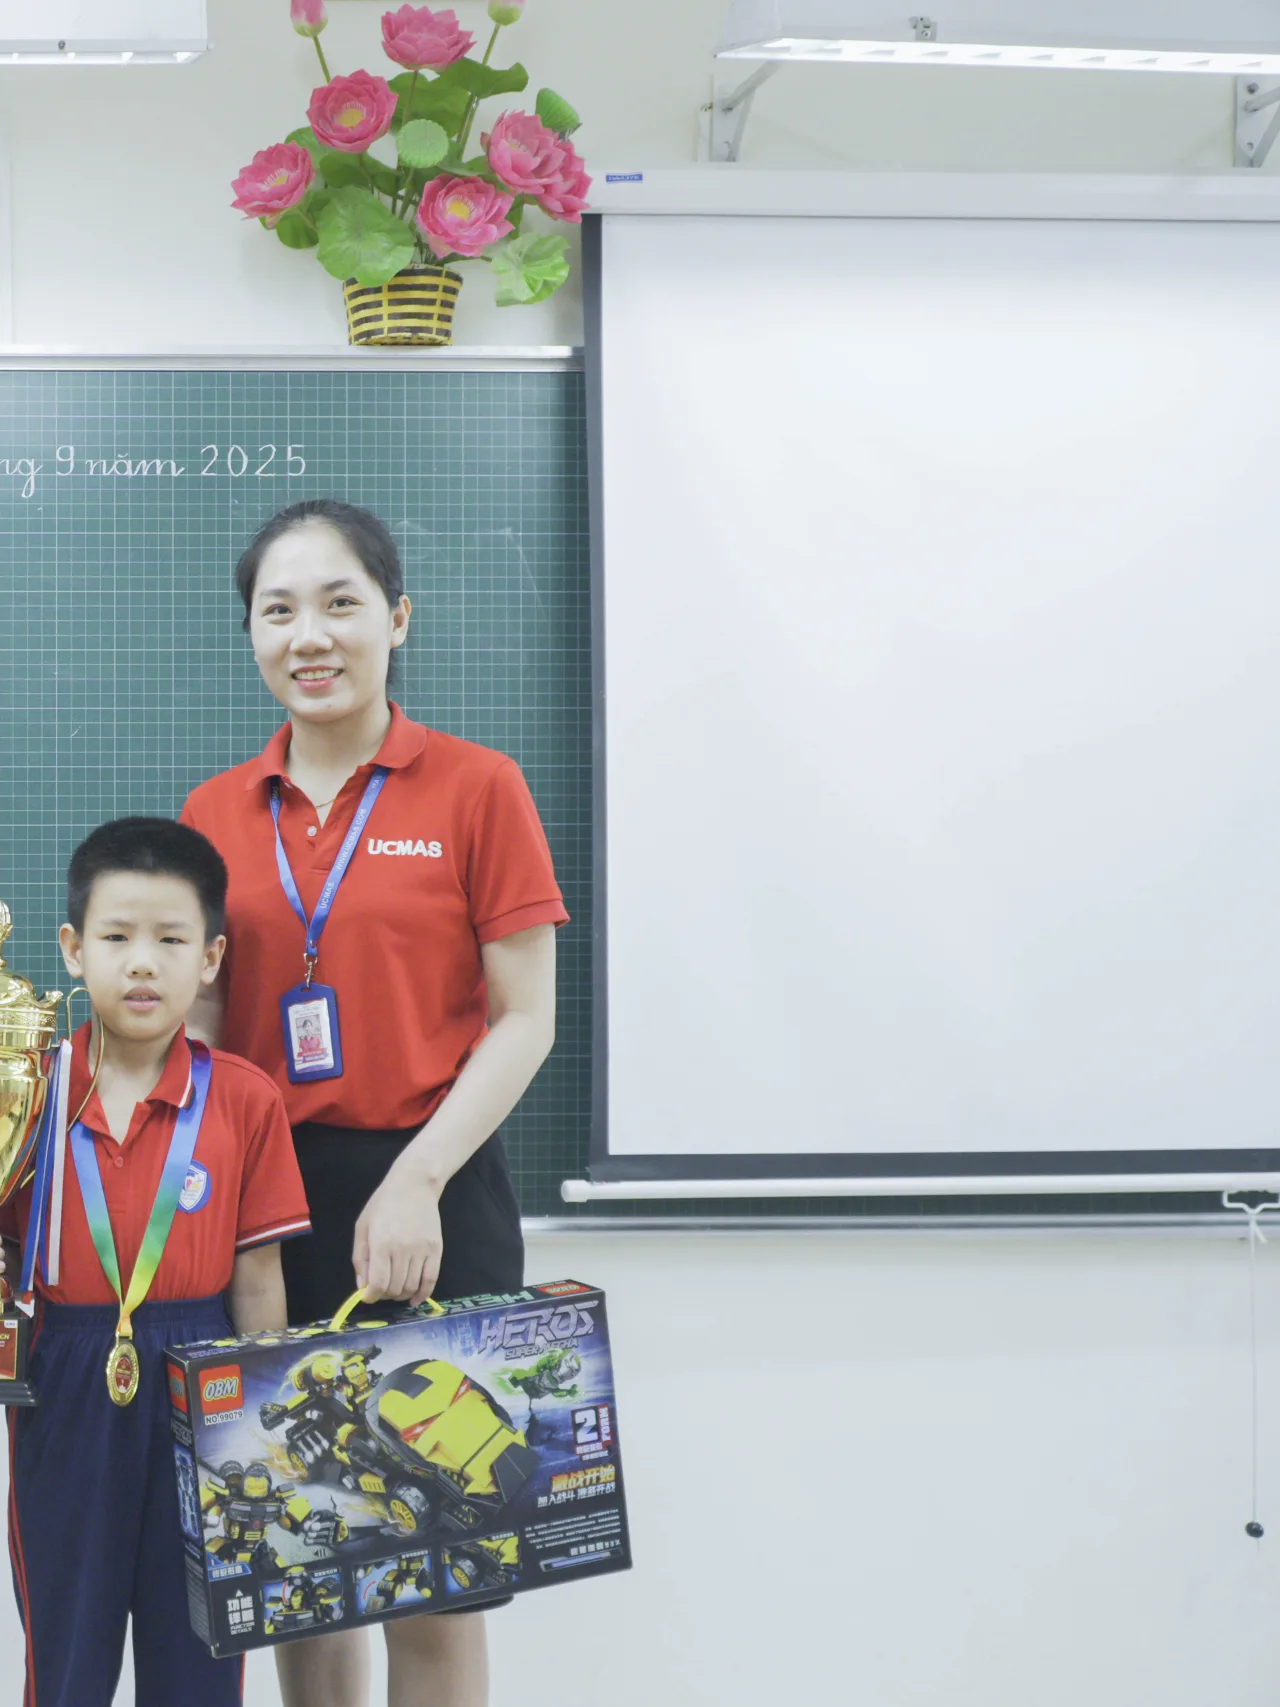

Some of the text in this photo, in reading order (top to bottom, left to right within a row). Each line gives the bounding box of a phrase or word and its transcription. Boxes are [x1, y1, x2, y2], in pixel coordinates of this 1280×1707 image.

[55, 444, 75, 476] 9
[84, 452, 186, 478] năm
[200, 443, 307, 477] 2025
[368, 838, 443, 858] UCMAS
[319, 881, 335, 909] UCMAS
[478, 1300, 599, 1354] HEROS
[505, 1345, 538, 1360] SUPER
[203, 1376, 239, 1401] OBM
[205, 1411, 244, 1425] NO.99079
[574, 1409, 598, 1443] 2
[598, 1406, 611, 1441] FORM
